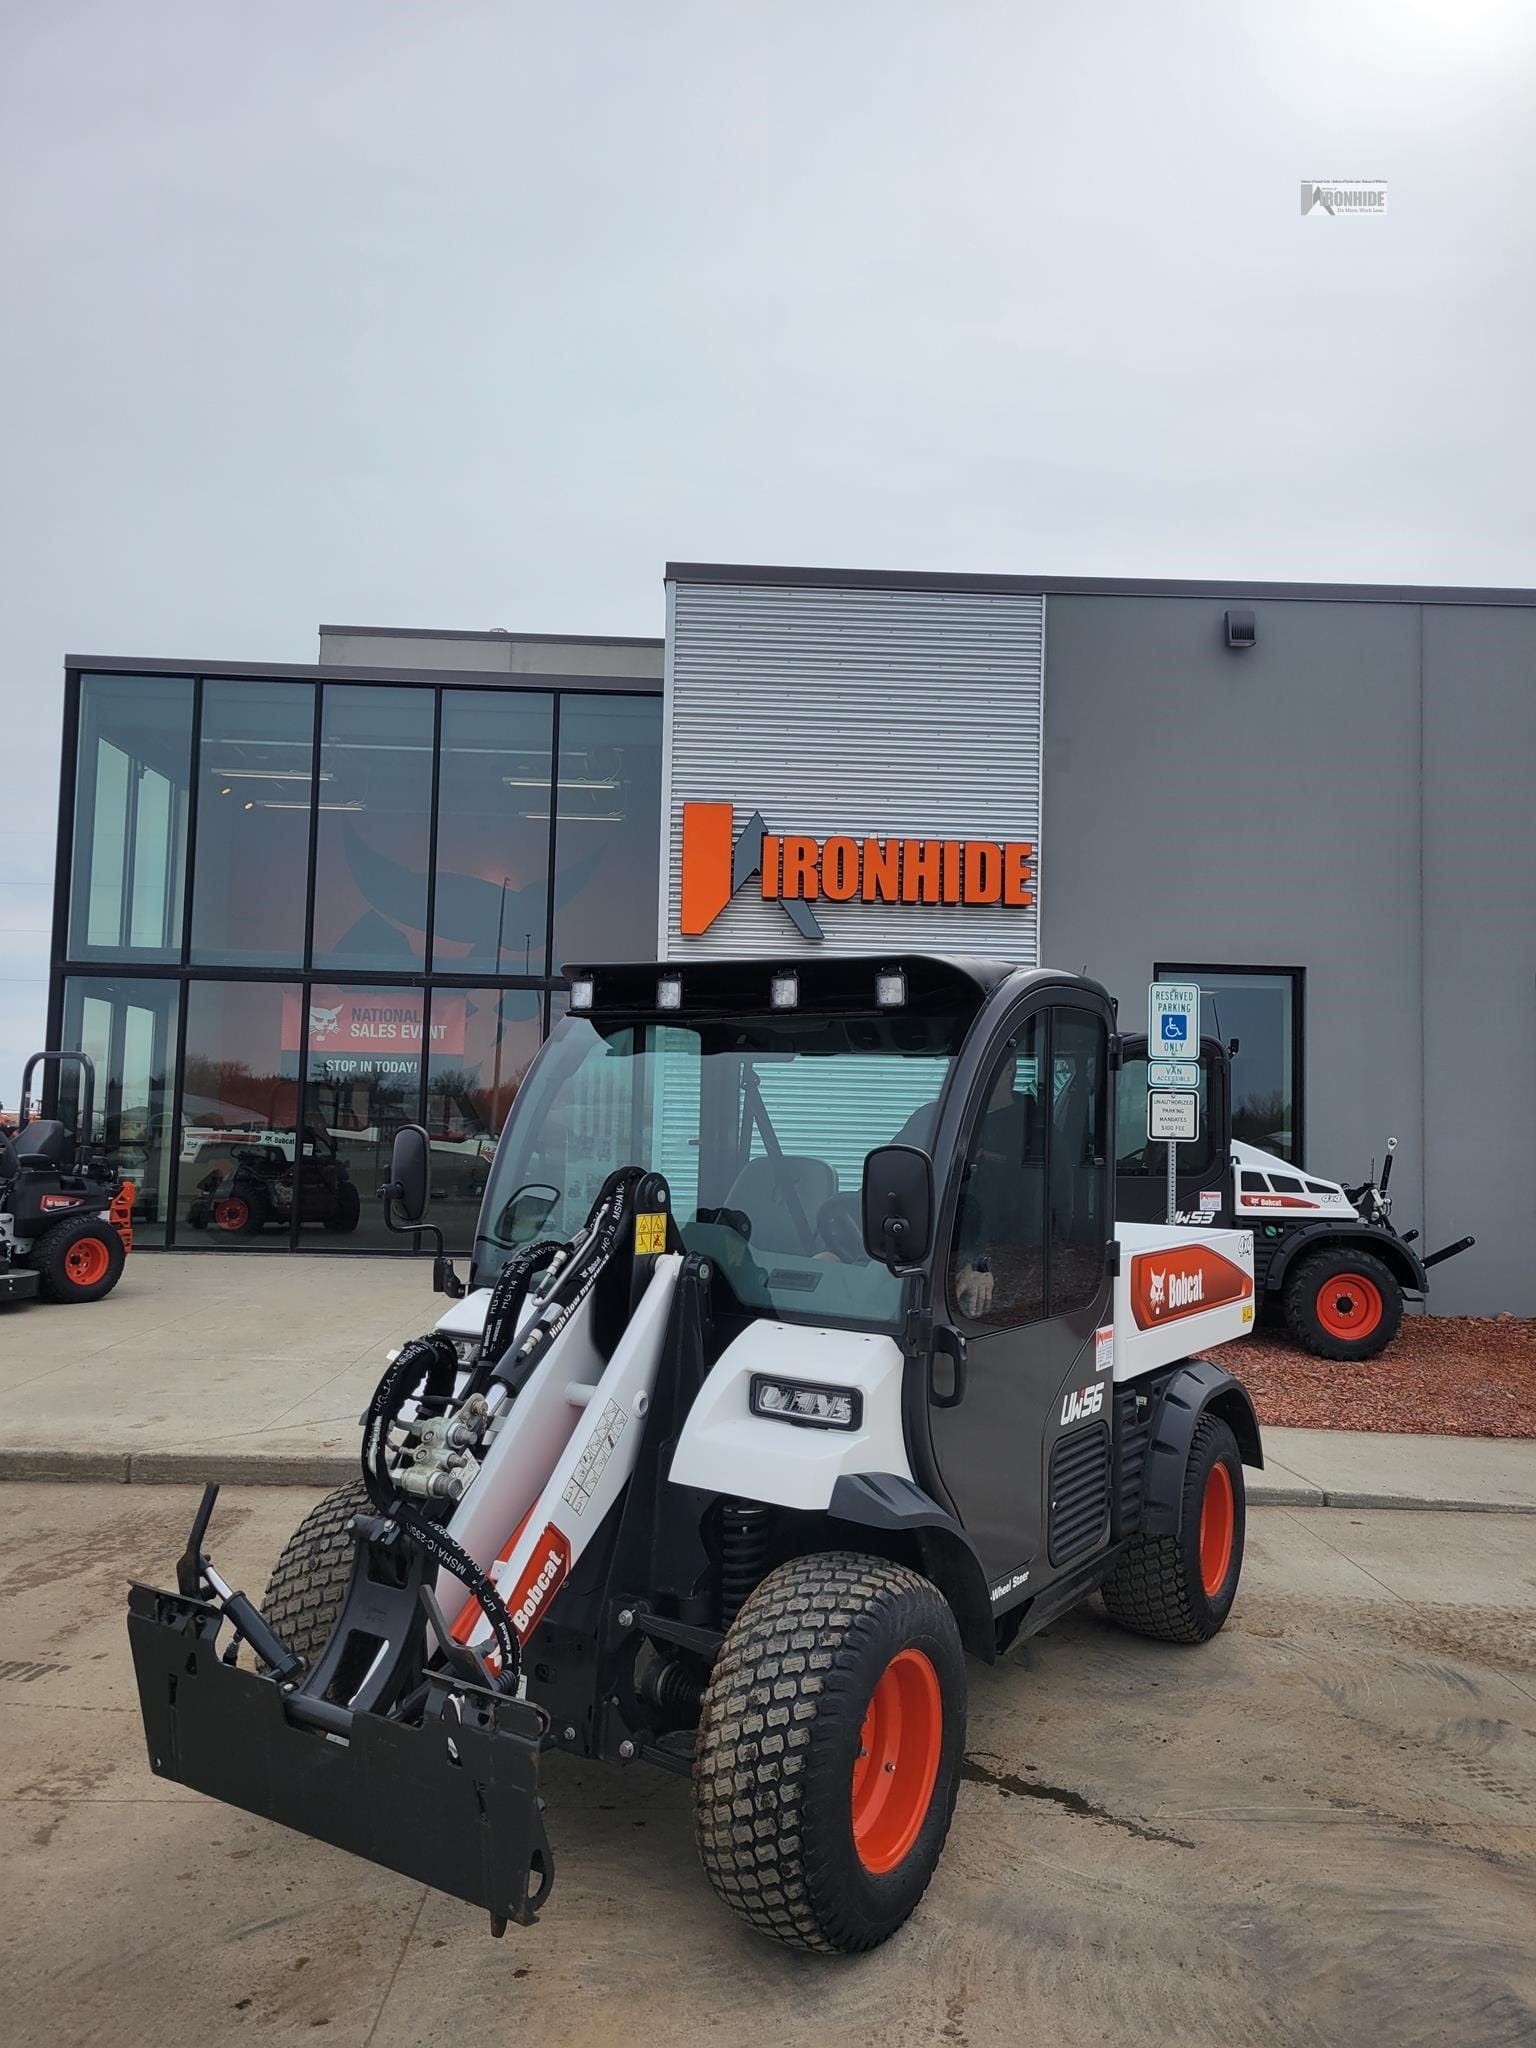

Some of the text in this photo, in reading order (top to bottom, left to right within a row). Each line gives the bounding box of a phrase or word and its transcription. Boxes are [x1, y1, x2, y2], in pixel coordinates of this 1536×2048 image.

[762, 835, 1034, 907] IRONHIDE
[1156, 990, 1193, 1001] RESERVED
[352, 1007, 421, 1023] NATIONAL
[1158, 1003, 1191, 1013] PARKING
[350, 1023, 447, 1040] SALES EVNT
[1164, 1042, 1184, 1052] ONLY
[326, 1060, 417, 1073] STOP IN TODAY!
[274, 1136, 295, 1146] Bobcat
[1169, 1269, 1203, 1309] Bobcat
[549, 1316, 567, 1340] High
[564, 1294, 581, 1320] Flow
[1060, 1382, 1105, 1426] UW56
[438, 1546, 467, 1576] MSHA
[1012, 1571, 1029, 1588] Steer
[513, 1550, 562, 1633] Bobcat
